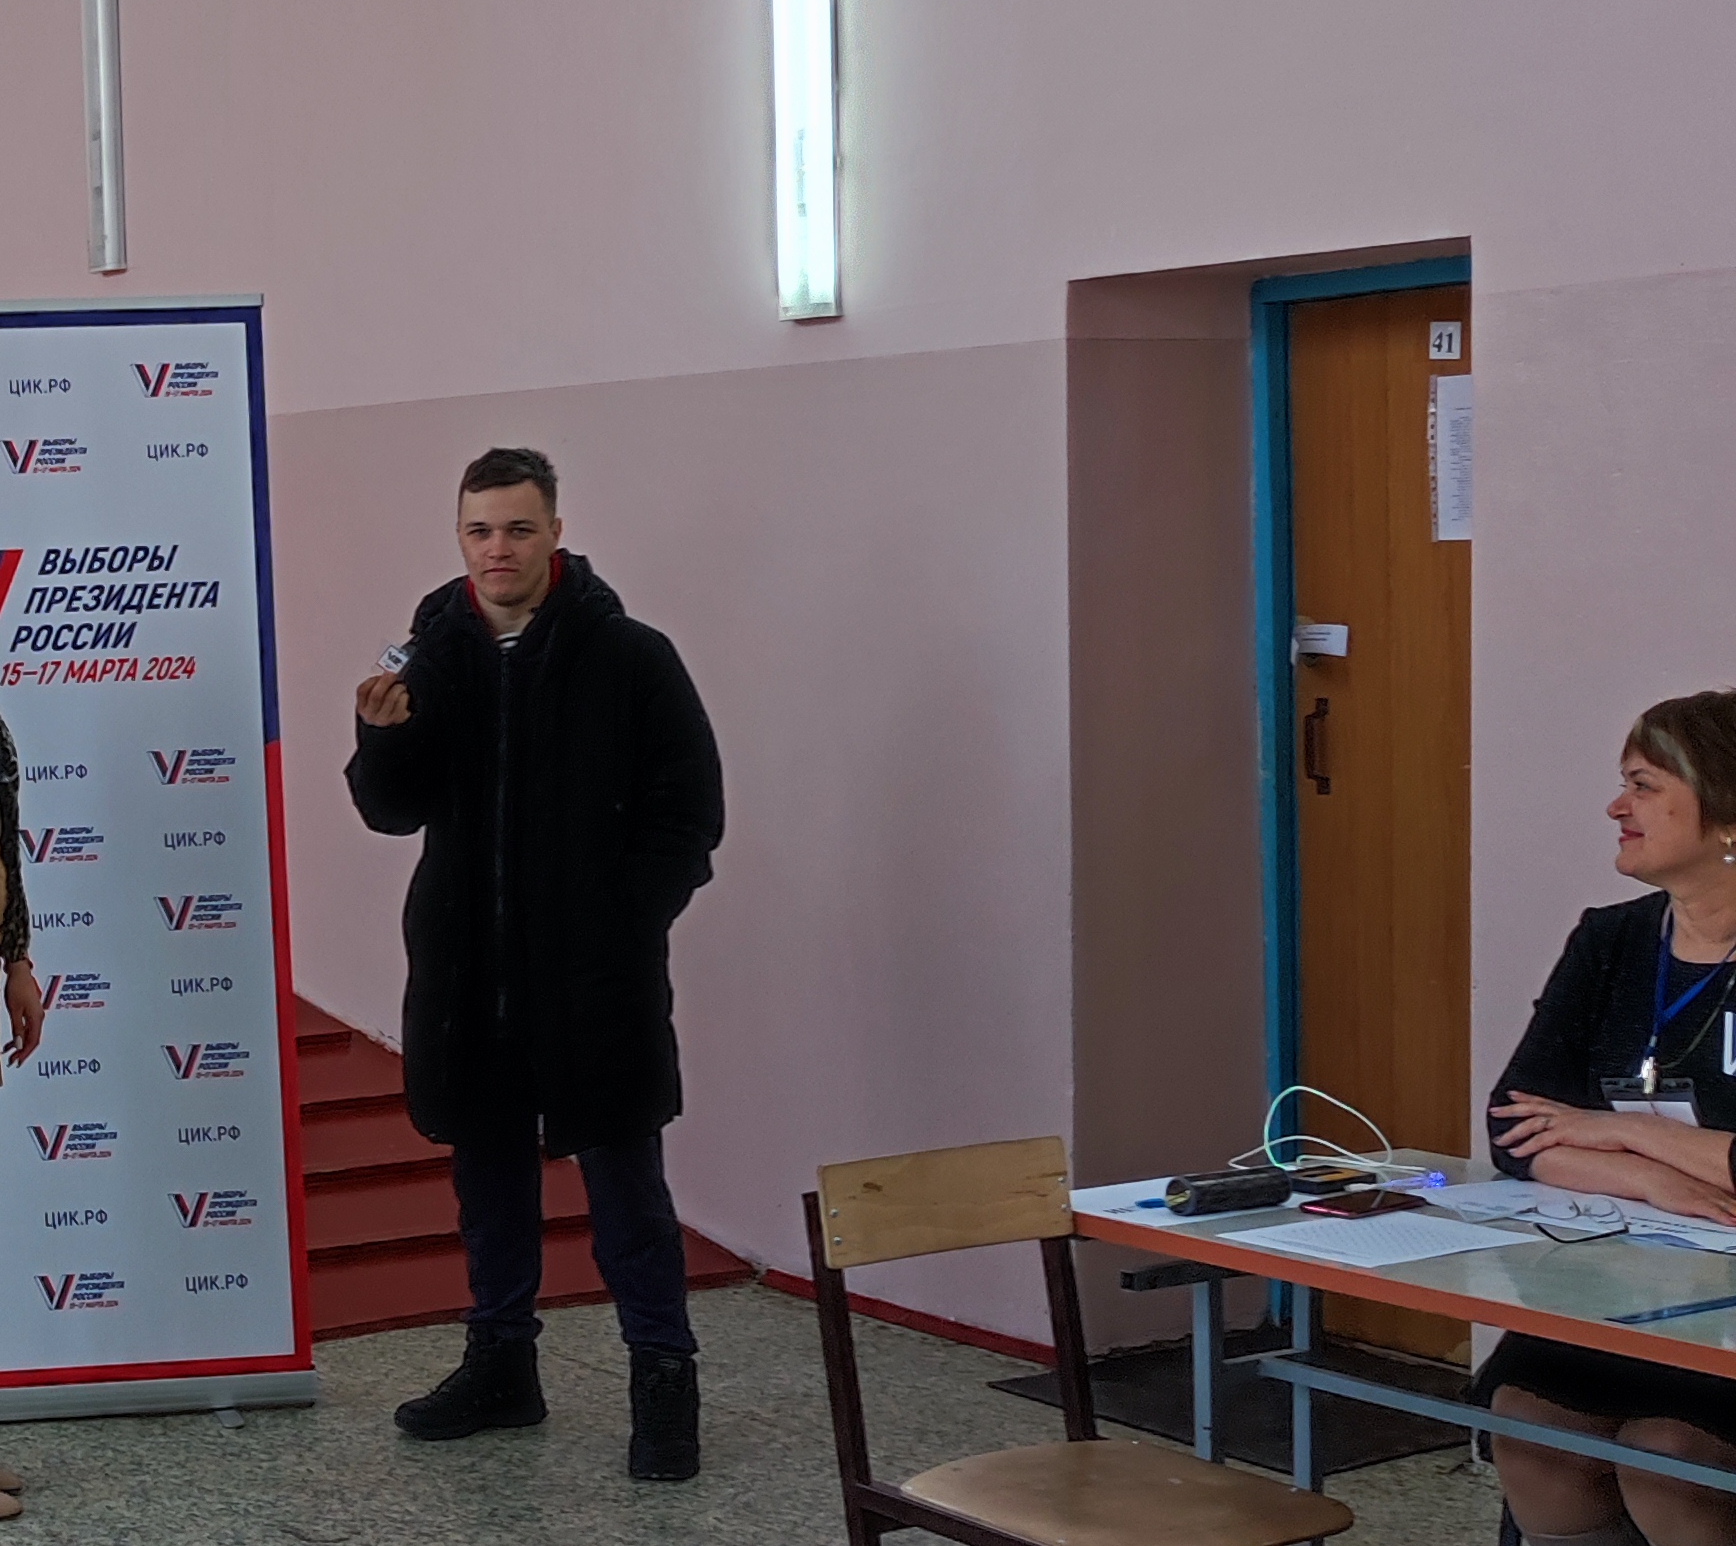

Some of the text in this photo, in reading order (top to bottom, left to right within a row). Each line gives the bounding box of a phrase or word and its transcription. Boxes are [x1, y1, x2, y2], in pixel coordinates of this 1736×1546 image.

[1432, 331, 1455, 354] 41
[9, 378, 70, 397] ЦИК.РФ
[147, 442, 208, 461] ЦИК.РФ
[38, 545, 179, 575] ВЫБОРЫ
[24, 581, 220, 614] ПРЕЗИДЕНТА
[10, 621, 138, 652] РОССИИ
[63, 658, 139, 684] МАРТА
[142, 656, 196, 681] 2024
[25, 763, 87, 783] ЦИК.РФ
[164, 830, 225, 850] ЦИК.РФ
[31, 911, 93, 931] ЦИК.РФ
[170, 976, 232, 996] ЦИК.РФ
[37, 1057, 101, 1077] ЦИК.РФ
[178, 1125, 240, 1145] ЦИК.РФ
[44, 1209, 107, 1229] ЦИК.РФ
[185, 1273, 248, 1294] ЦИК.РФ
